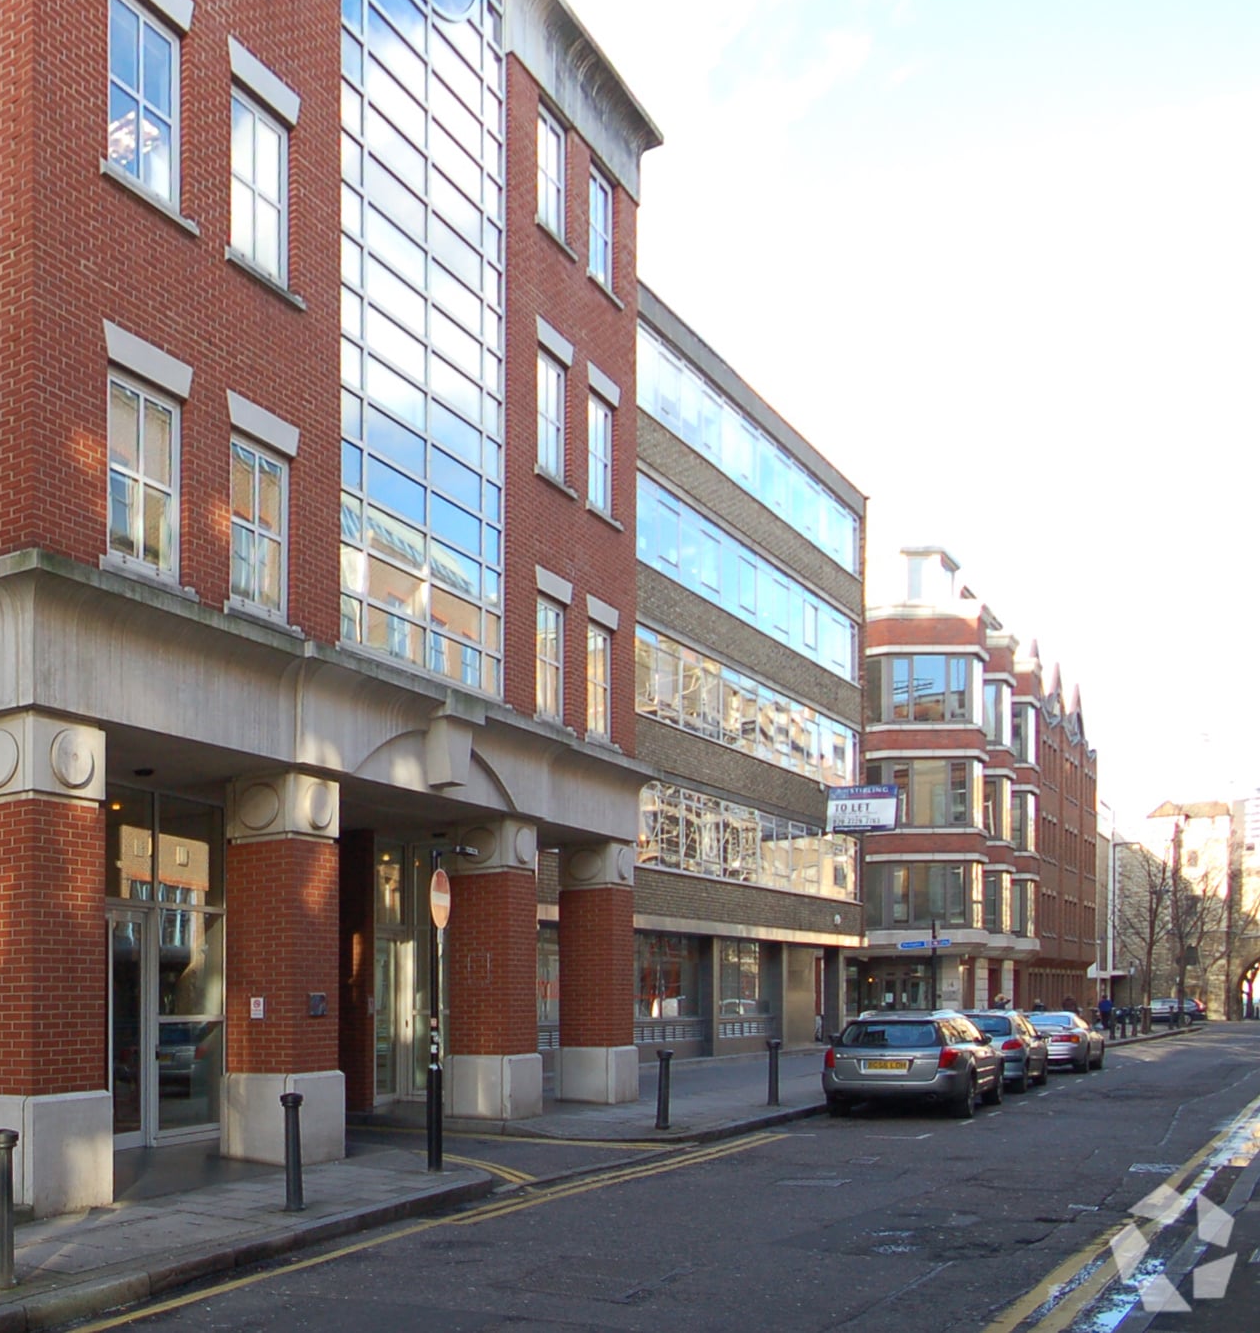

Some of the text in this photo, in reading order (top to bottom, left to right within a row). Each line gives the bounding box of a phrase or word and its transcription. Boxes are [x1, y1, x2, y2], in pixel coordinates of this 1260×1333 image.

[850, 786, 889, 794] STIRLING
[835, 803, 870, 812] TO LET
